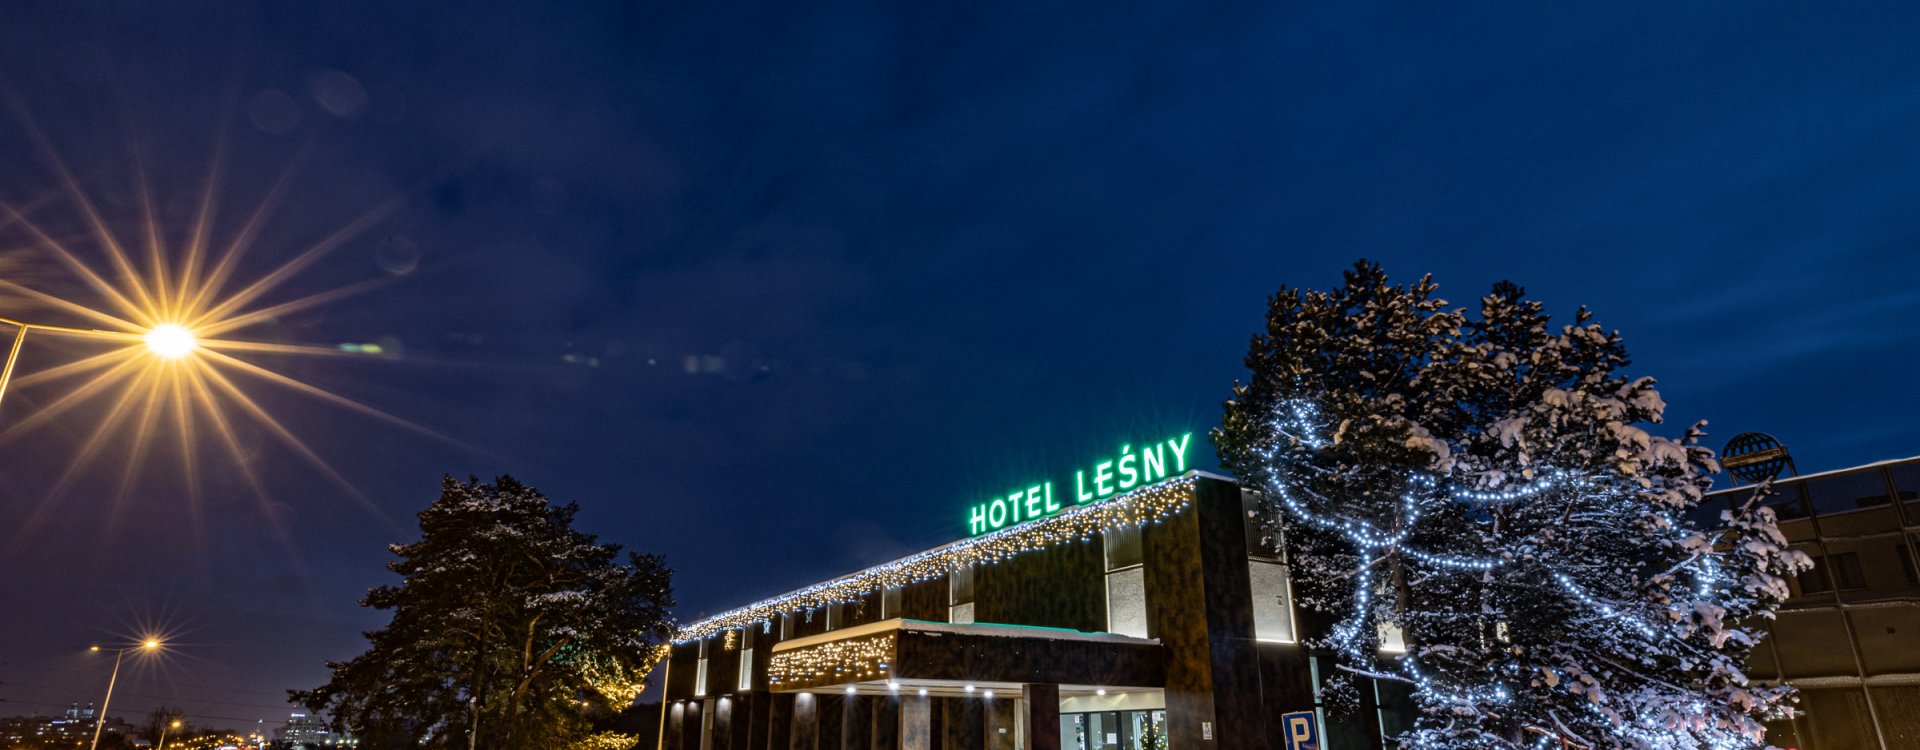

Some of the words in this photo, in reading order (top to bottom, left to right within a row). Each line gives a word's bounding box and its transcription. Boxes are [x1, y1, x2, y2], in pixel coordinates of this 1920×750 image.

[969, 482, 1060, 535] HOTEL
[1077, 432, 1192, 503] LEŚNY
[1290, 717, 1310, 750] P
